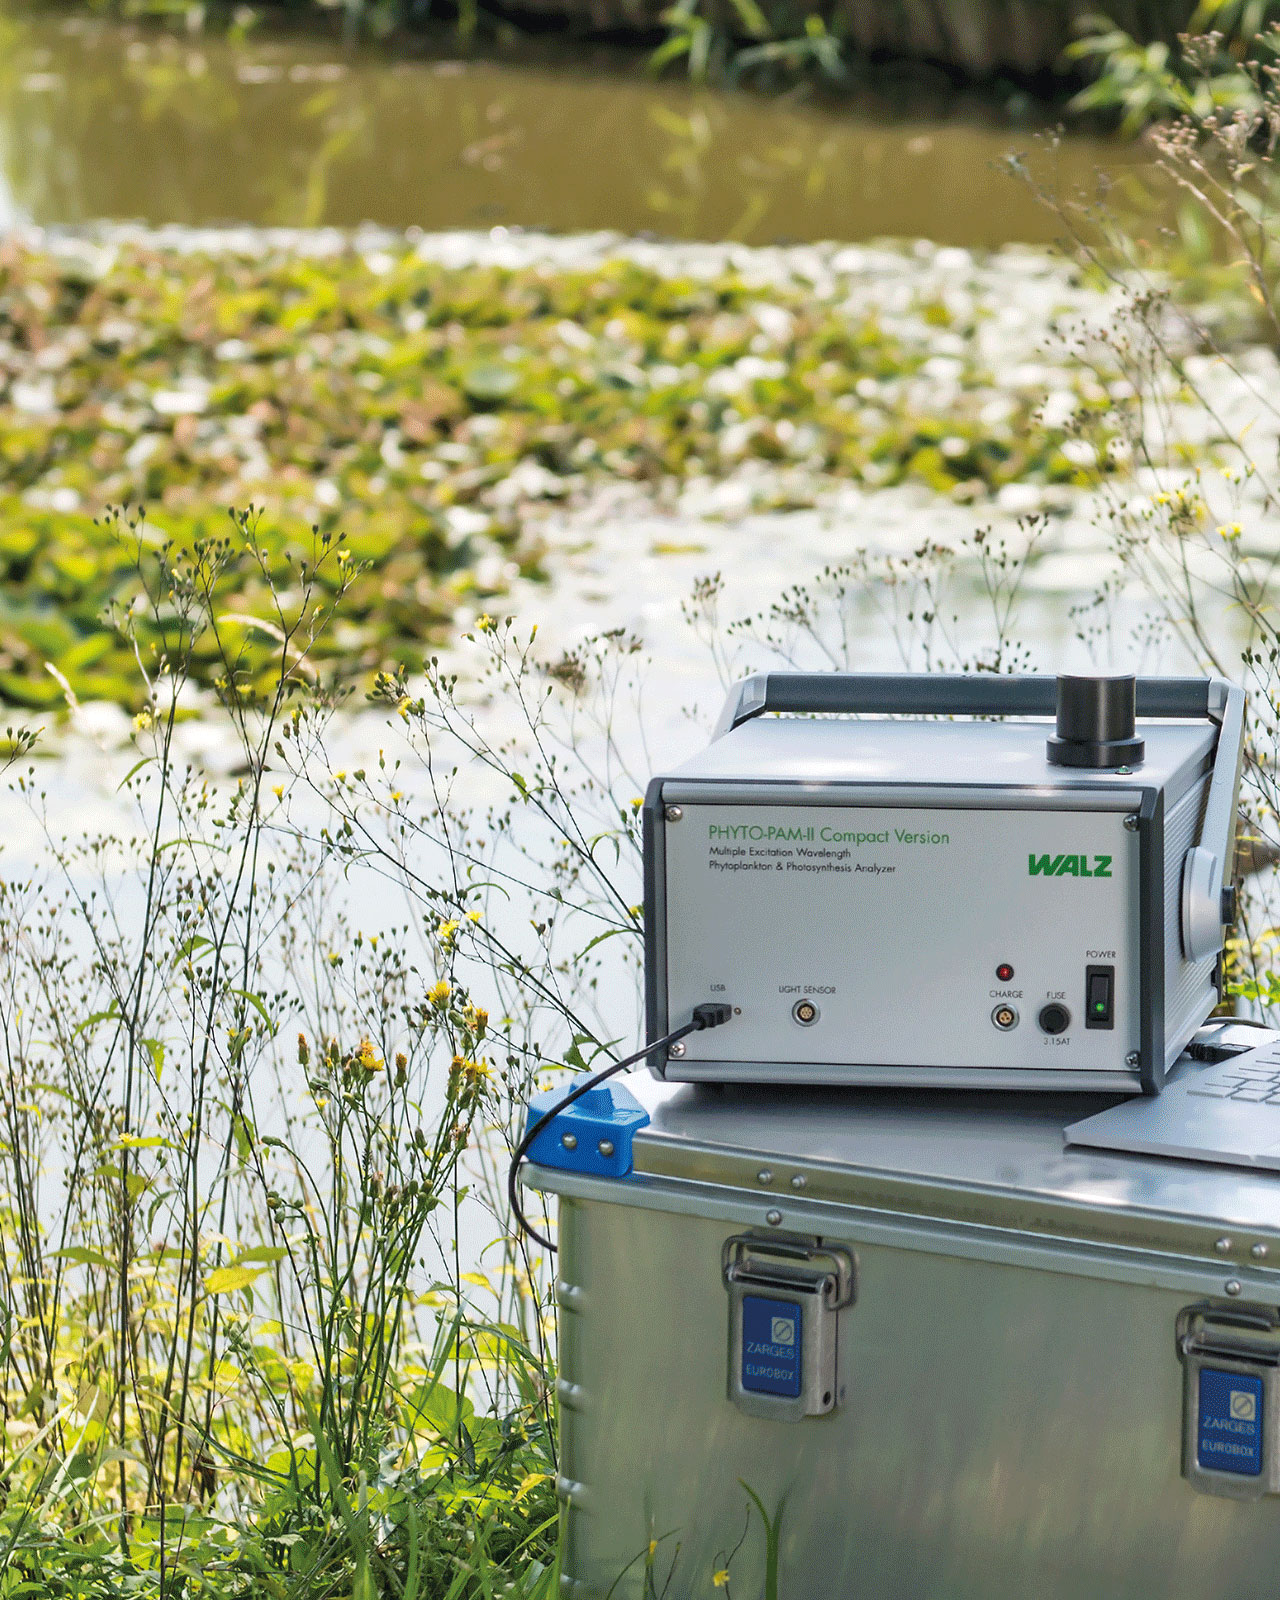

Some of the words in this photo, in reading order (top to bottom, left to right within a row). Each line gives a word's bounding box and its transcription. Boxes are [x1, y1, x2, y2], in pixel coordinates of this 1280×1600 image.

[708, 824, 814, 842] PHYTO-PAM-II
[820, 826, 889, 846] Compact
[894, 828, 950, 844] Version
[708, 846, 746, 858] Multiple
[749, 847, 793, 857] Excitation
[796, 847, 851, 860] Wavelength
[708, 860, 773, 872] Phytoplankton
[775, 861, 784, 871] &
[786, 861, 852, 873] Photosynthesis
[854, 863, 896, 875] Analyzer
[1028, 853, 1113, 877] WALZ
[1085, 950, 1117, 959] POWER
[709, 984, 726, 992] USB
[778, 985, 801, 994] LIGHT
[803, 986, 837, 995] SENSOR
[989, 990, 1024, 999] CHARGE
[1046, 991, 1066, 1000] FUSE
[1043, 1037, 1071, 1046] 3.15AT
[746, 1341, 795, 1360] ZARGES
[746, 1363, 794, 1380] EUROBOX
[1202, 1415, 1255, 1435] ZARGES
[1202, 1439, 1254, 1457] EUROBOX
